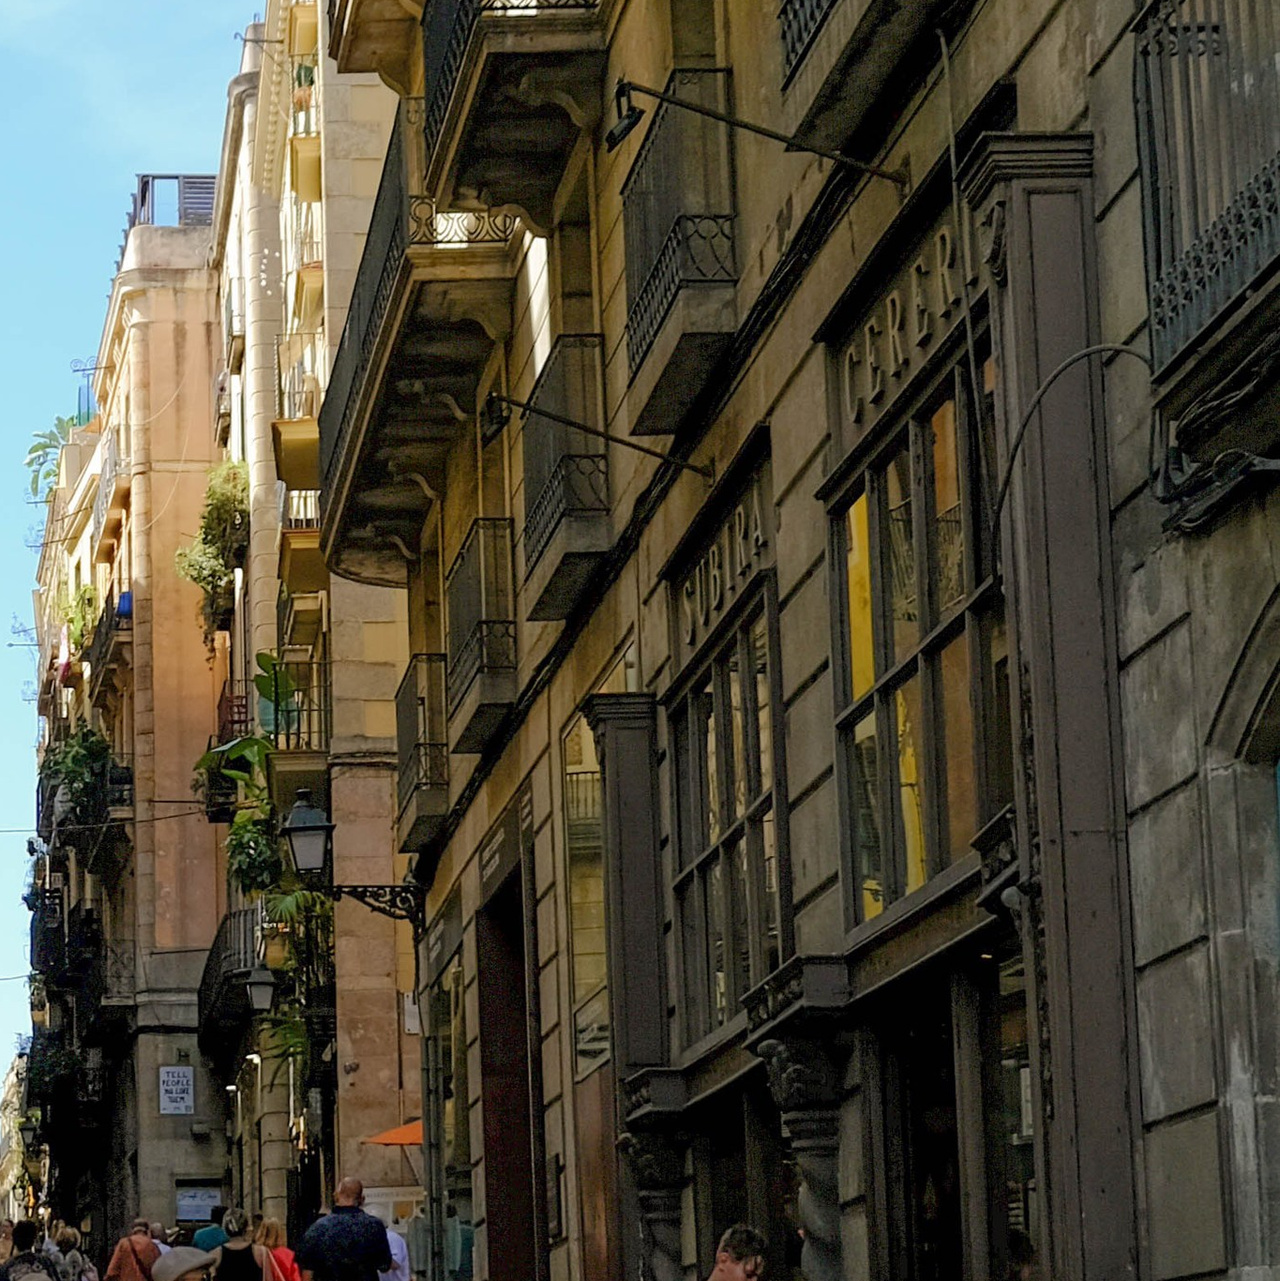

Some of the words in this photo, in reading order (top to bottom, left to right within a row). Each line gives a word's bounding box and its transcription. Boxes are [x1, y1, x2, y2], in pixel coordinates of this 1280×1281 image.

[844, 198, 979, 426] CERERI
[682, 486, 769, 646] SUBIRA
[166, 1071, 188, 1079] TELL
[162, 1079, 191, 1087] PEOPLE
[175, 1087, 189, 1095] LOVE
